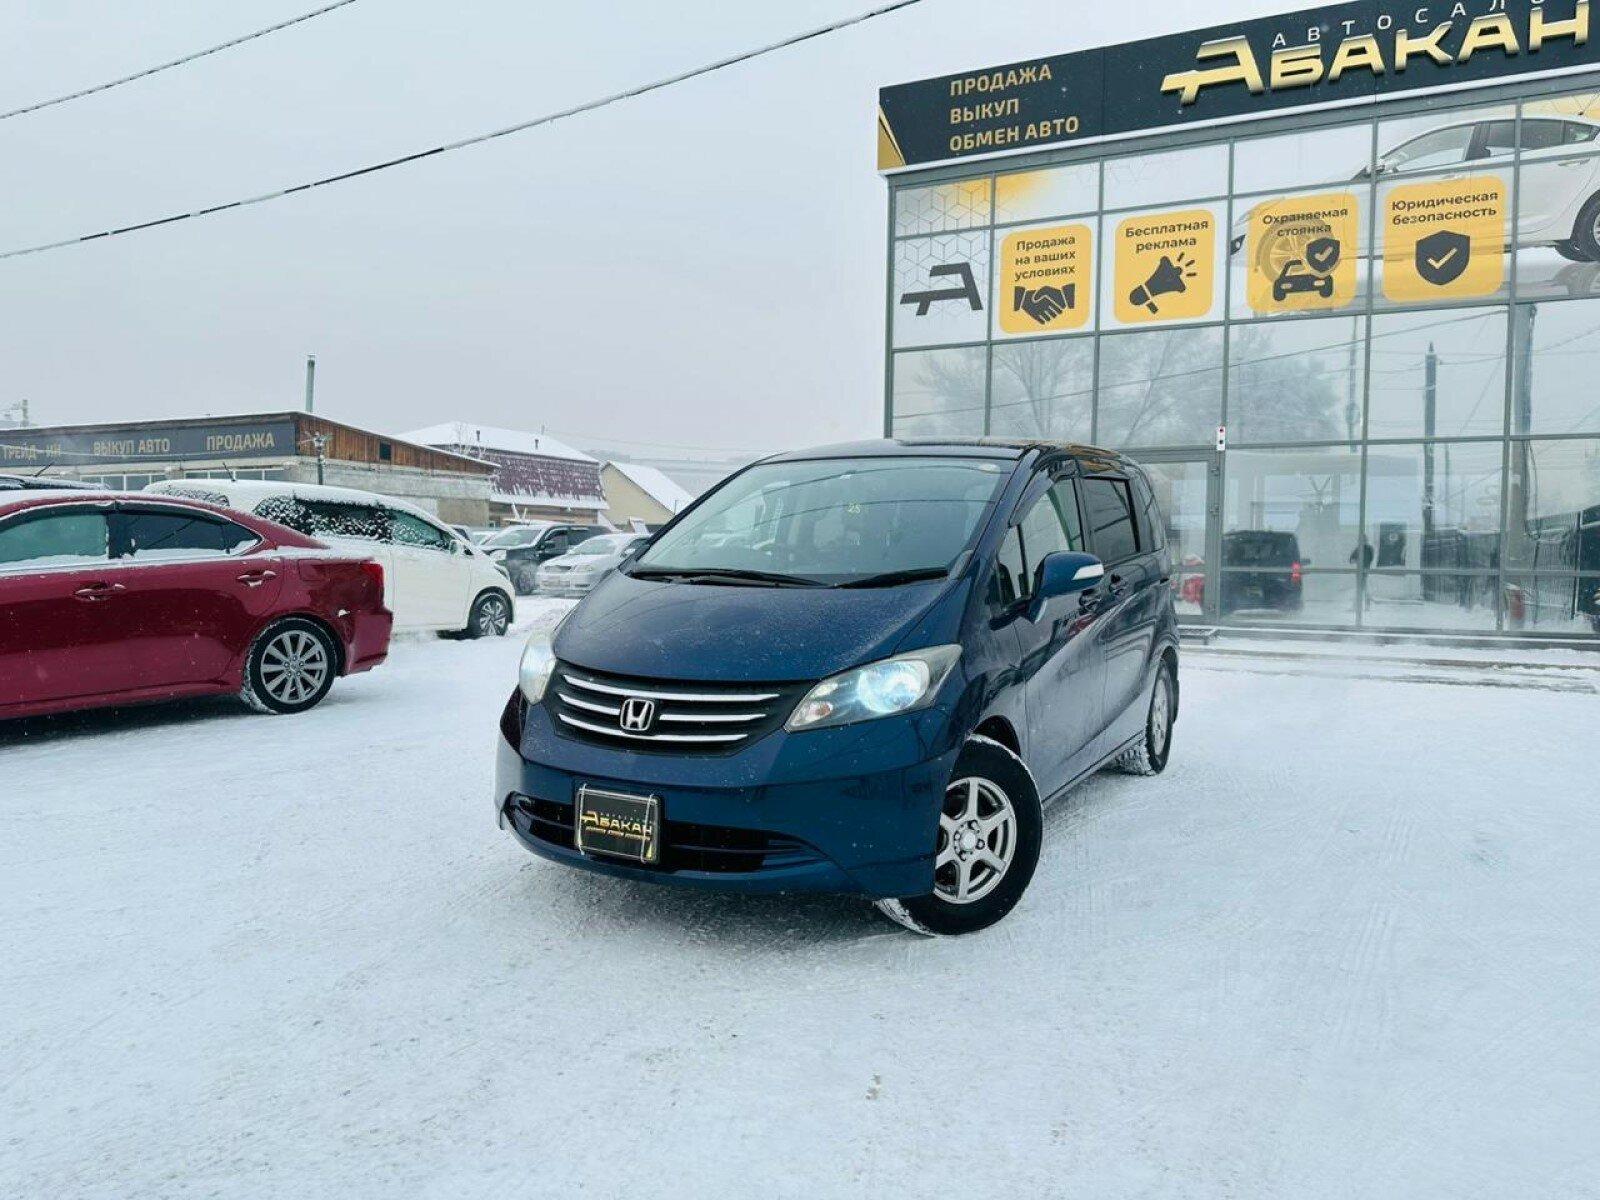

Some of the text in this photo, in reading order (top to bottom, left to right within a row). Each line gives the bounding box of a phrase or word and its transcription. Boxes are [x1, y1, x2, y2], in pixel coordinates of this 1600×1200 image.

[1272, 0, 1546, 48] АВТОСАЛ
[1160, 0, 1590, 105] АБАКАН
[950, 64, 1052, 96] ПРОДАЖА
[950, 98, 1019, 125] ВЫКУП
[949, 115, 1079, 151] ОБМЕН АВТО
[1391, 191, 1499, 212] Юридическая
[1262, 207, 1349, 225] Охраняемая
[1392, 207, 1498, 226] безопасность
[1125, 219, 1210, 238] Бесплатная
[1276, 223, 1332, 237] стоянка
[1016, 235, 1076, 252] Продажа
[1135, 236, 1198, 254] реклама
[1014, 250, 1077, 266] на ваших
[1014, 265, 1077, 282] условиях
[93, 437, 171, 456] ВЫКУП АВТО
[206, 432, 276, 451] ПРОДАЖА
